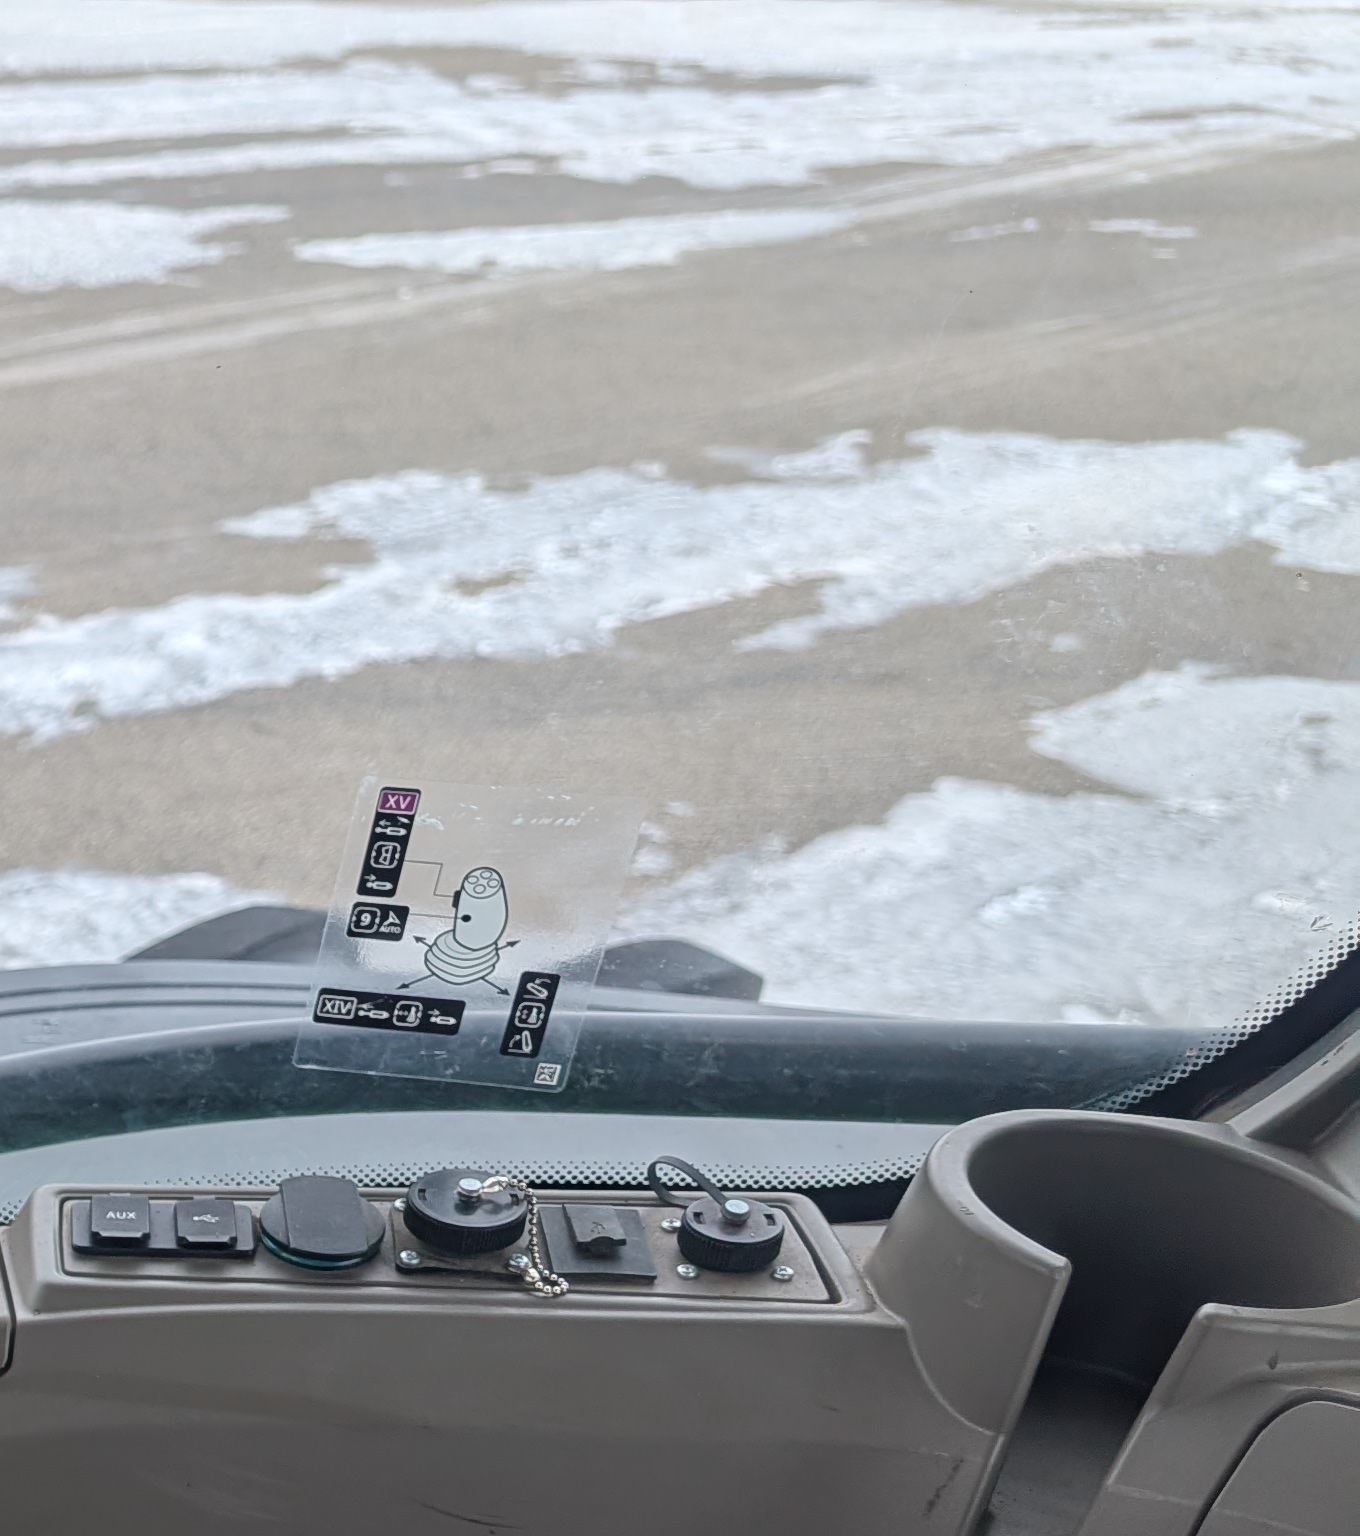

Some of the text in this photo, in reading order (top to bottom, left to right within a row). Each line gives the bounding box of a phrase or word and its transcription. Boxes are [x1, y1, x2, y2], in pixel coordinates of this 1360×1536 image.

[386, 795, 411, 810] XV
[359, 914, 371, 926] 9
[323, 999, 352, 1015] XIV
[106, 1211, 137, 1220] AUX
